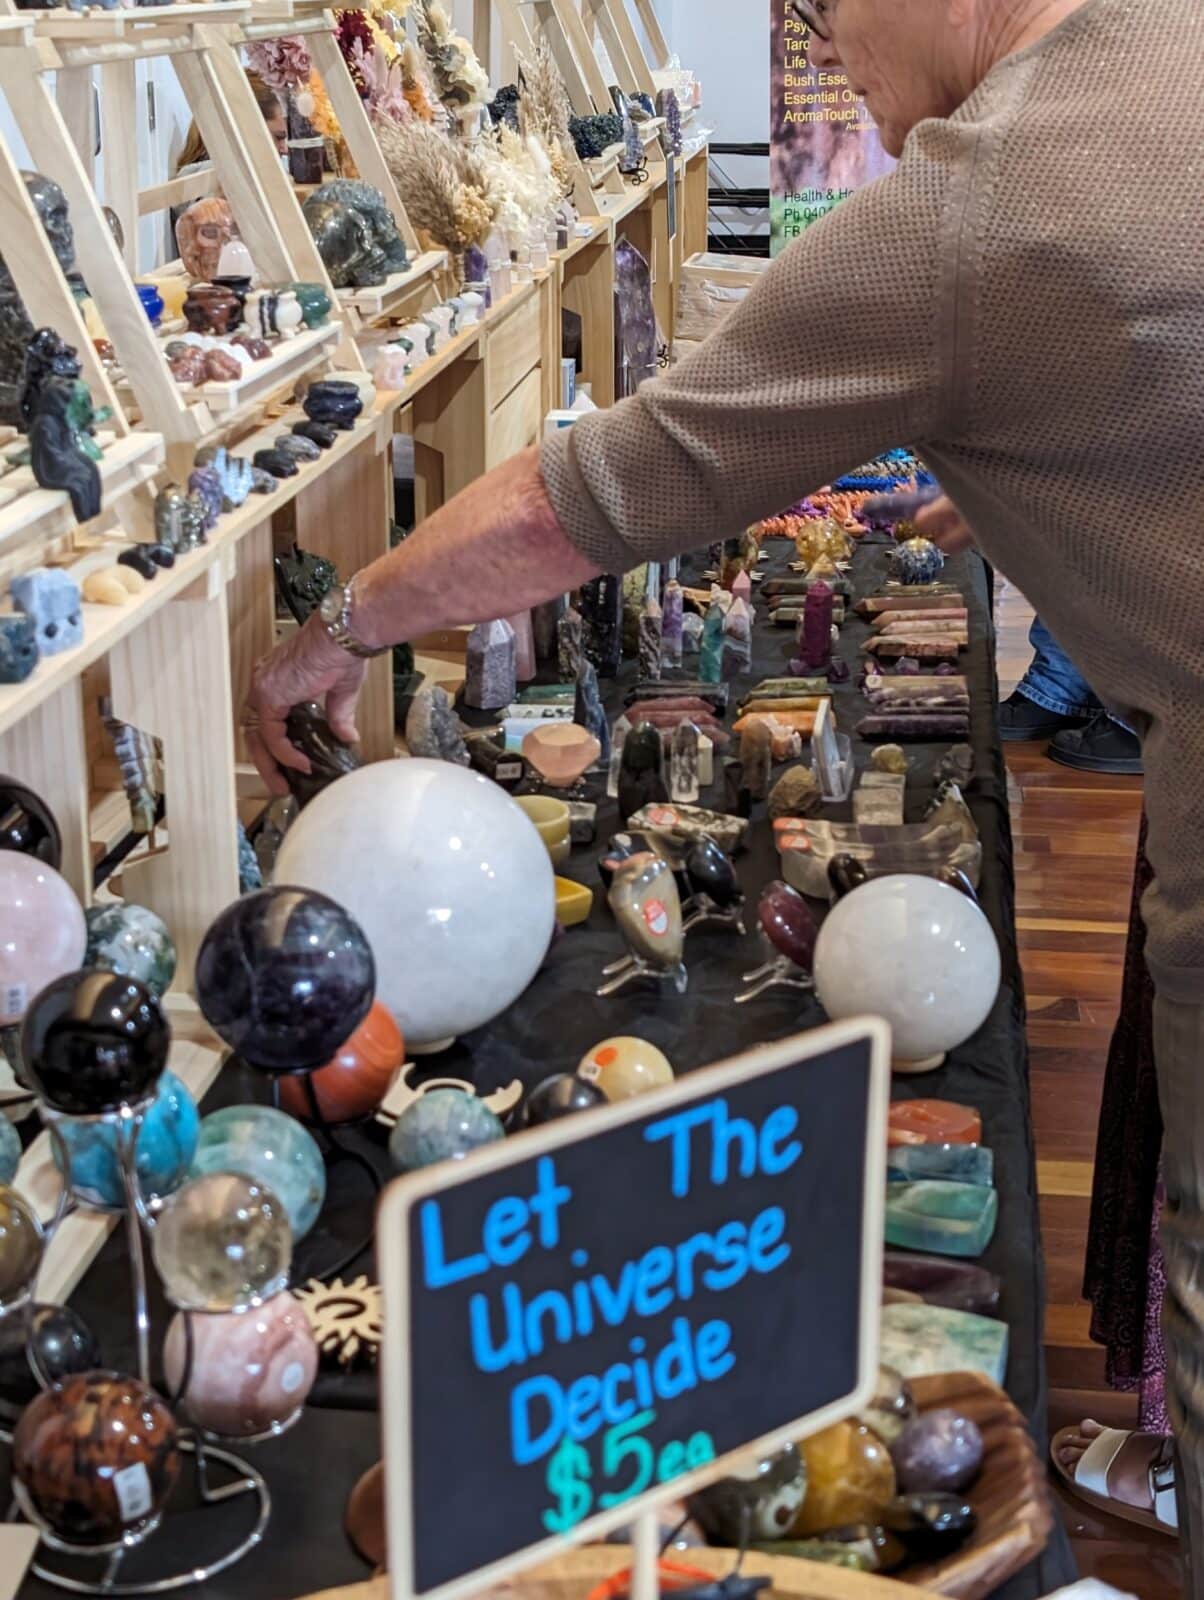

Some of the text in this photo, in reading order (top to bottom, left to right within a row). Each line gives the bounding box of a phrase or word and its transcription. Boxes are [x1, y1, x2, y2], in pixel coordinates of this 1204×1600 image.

[784, 56, 807, 69] Life
[784, 73, 815, 87] Bush
[784, 90, 838, 105] Essential
[783, 107, 858, 123] AromaTouch
[783, 190, 822, 203] Health
[826, 188, 834, 201] &
[803, 206, 833, 220] 040
[784, 225, 801, 239] FB
[420, 1098, 803, 1289] Let The
[469, 1206, 792, 1373] Universe
[510, 1317, 736, 1466] Decide
